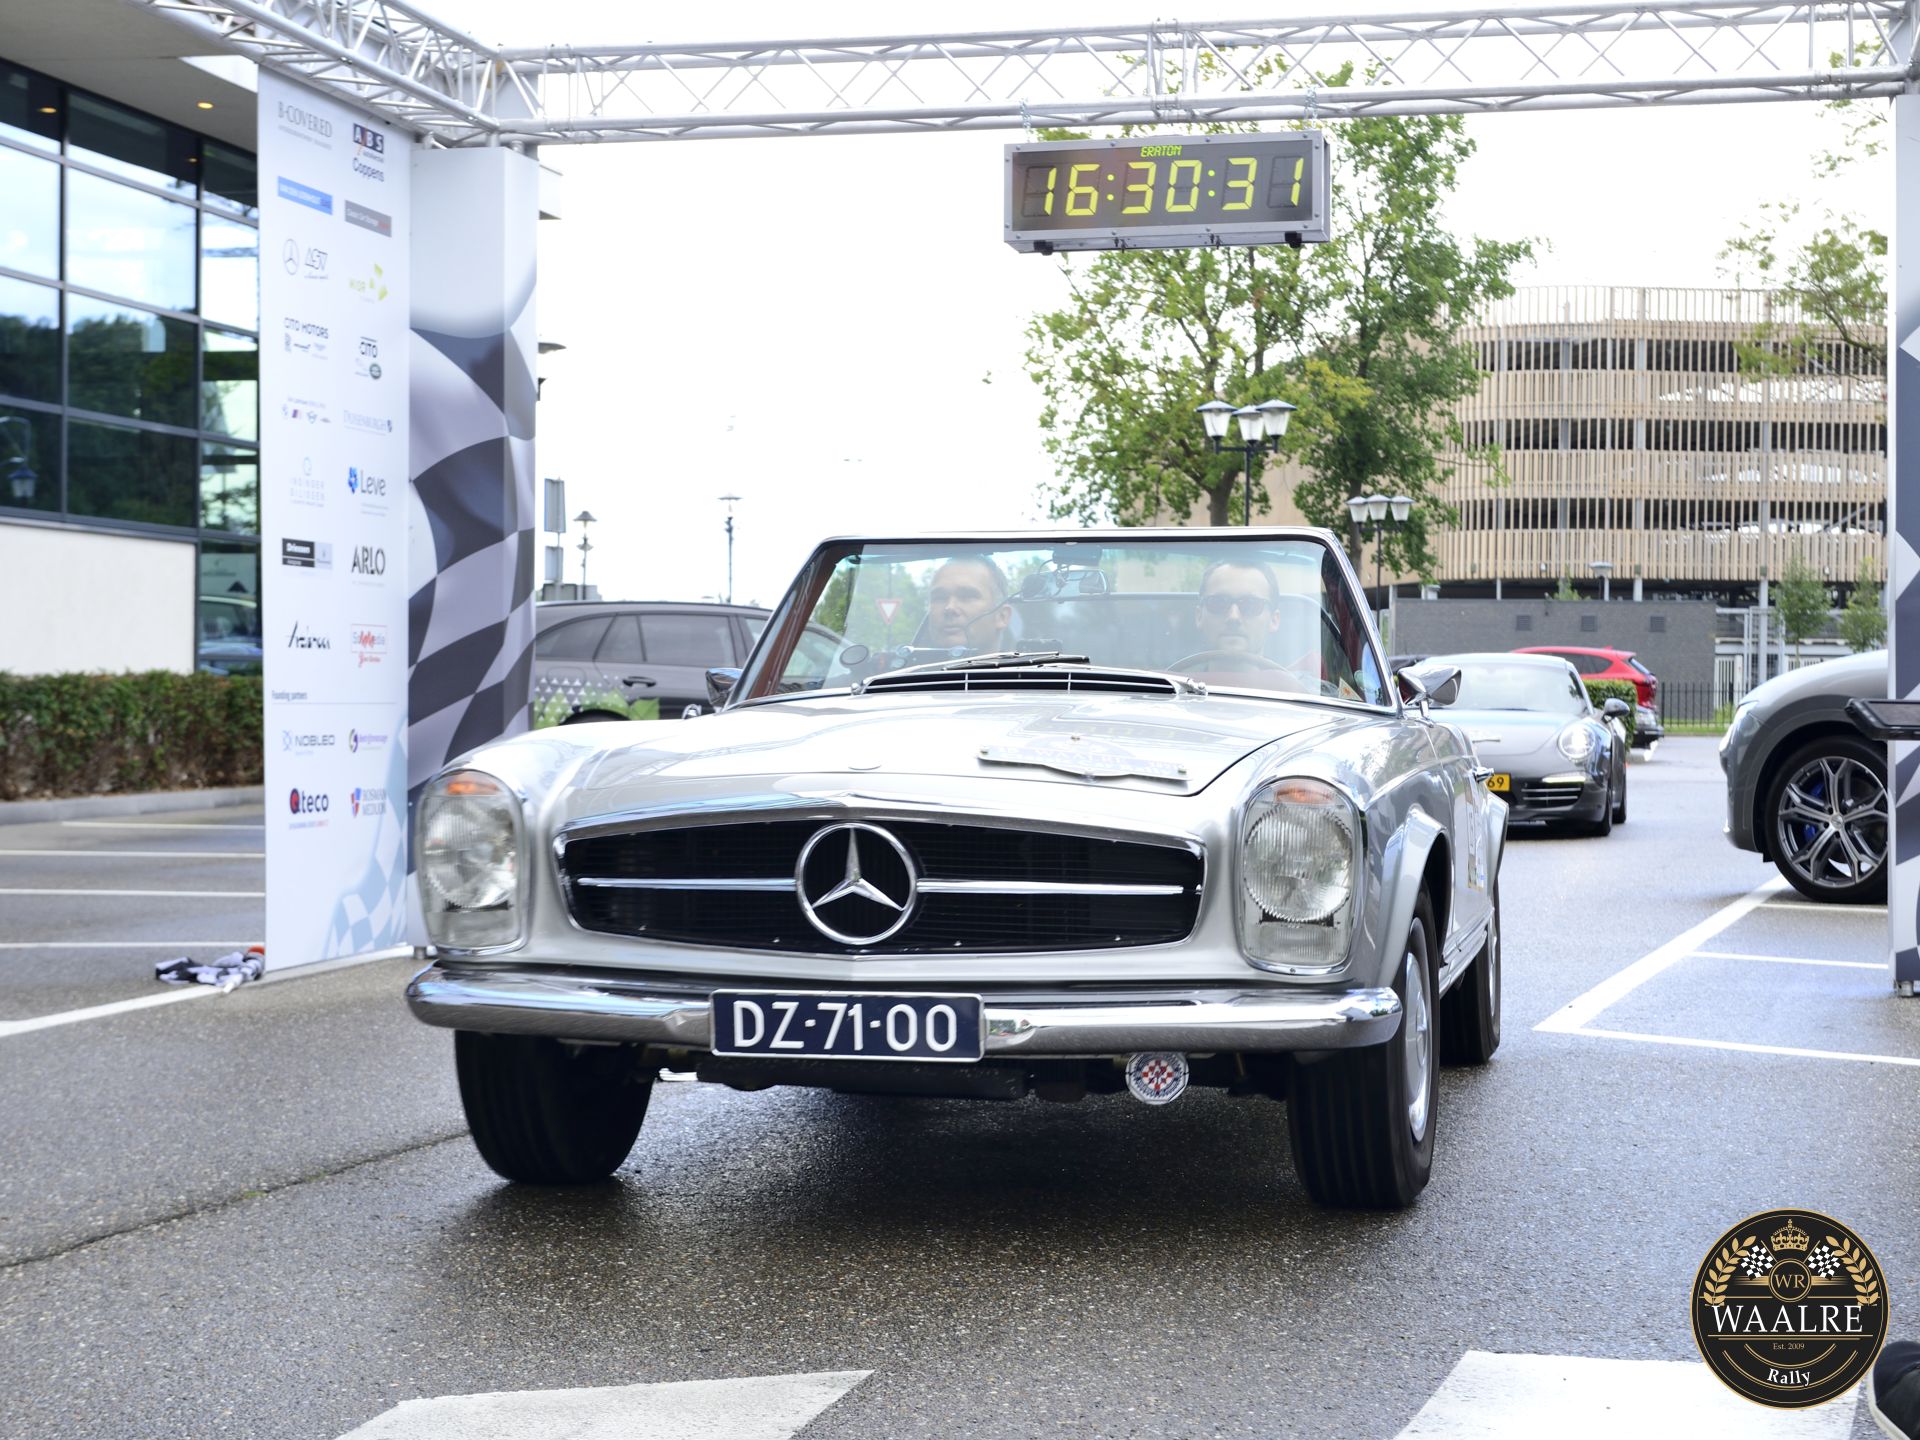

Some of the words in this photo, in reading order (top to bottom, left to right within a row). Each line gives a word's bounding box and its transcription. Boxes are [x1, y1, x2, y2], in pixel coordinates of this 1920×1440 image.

[1141, 145, 1182, 157] ERATON
[352, 157, 384, 182] Coppens
[1044, 157, 1304, 216] 16:30:31
[302, 323, 328, 339] MOTORS
[733, 1000, 957, 1051] DZ-71-00
